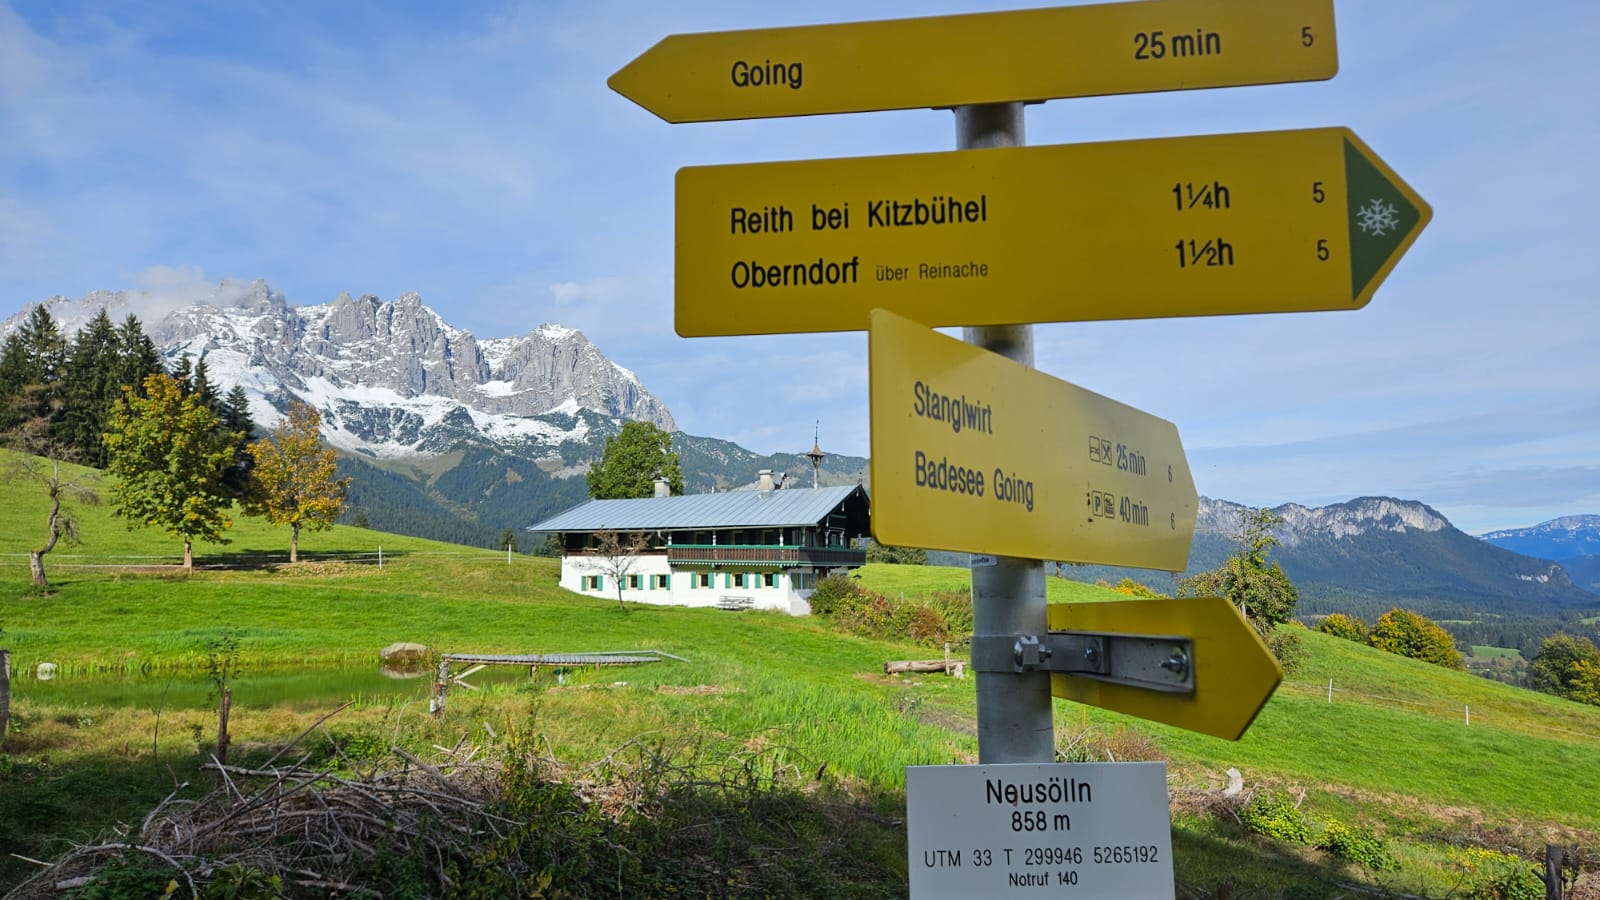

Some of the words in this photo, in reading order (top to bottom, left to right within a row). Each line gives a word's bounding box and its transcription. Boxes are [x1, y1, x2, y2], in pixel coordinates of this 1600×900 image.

[731, 59, 804, 90] Going
[1134, 31, 1166, 60] 25
[1172, 28, 1221, 57] min
[1301, 26, 1314, 47] 5
[731, 205, 793, 234] Reith
[812, 202, 849, 231] bei
[868, 195, 987, 228] Kitzbühel
[1312, 182, 1325, 203] 5
[731, 256, 859, 289] Oberndorf
[876, 265, 909, 282] über
[919, 261, 989, 280] Reinache
[1317, 239, 1330, 261] 5
[914, 381, 993, 435] Stanglwirt
[915, 451, 984, 498] Badesee
[994, 468, 1034, 513] Going
[986, 777, 1092, 804] Neusölln
[1011, 811, 1047, 832] 858
[1054, 814, 1070, 831] m
[924, 849, 961, 868] UTM
[973, 849, 992, 867] 33
[1003, 849, 1013, 866] T
[1025, 848, 1082, 866] 299946
[1094, 846, 1158, 864] 5265192
[1009, 871, 1049, 888] Notruf
[1057, 871, 1078, 886] 140
